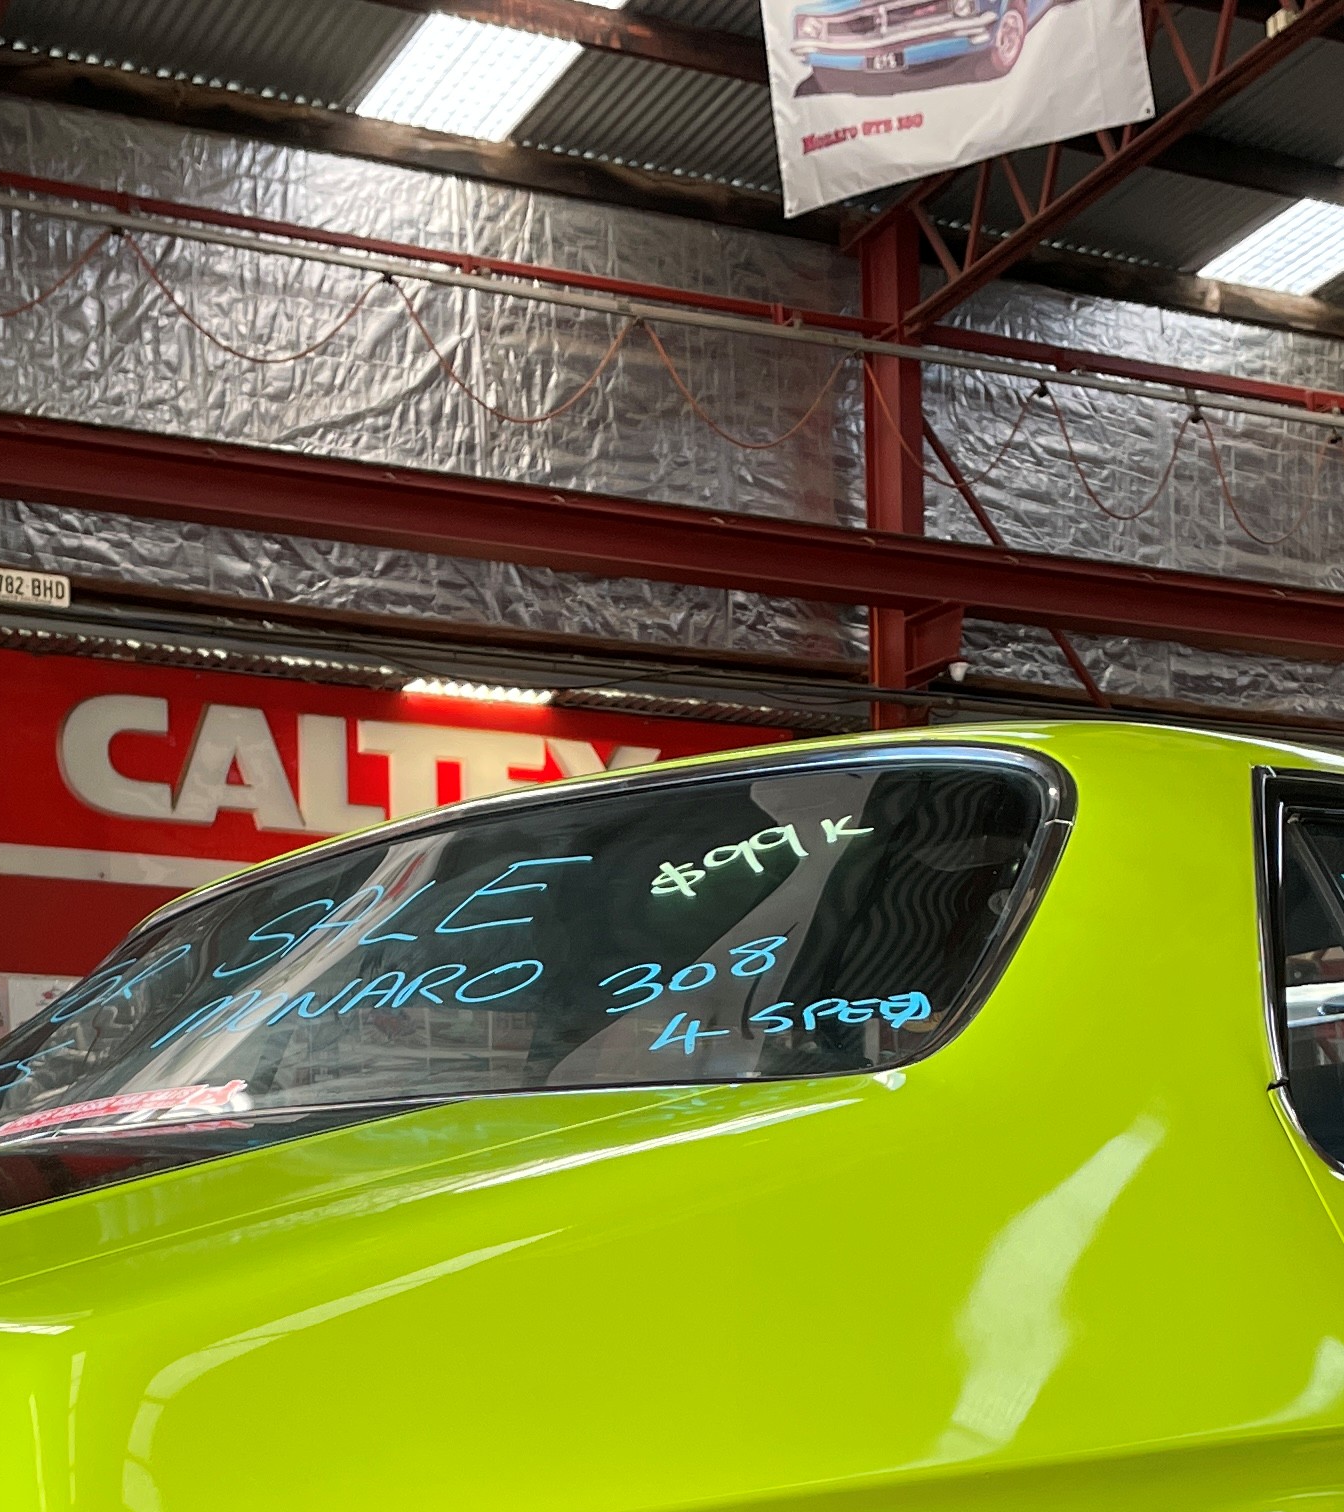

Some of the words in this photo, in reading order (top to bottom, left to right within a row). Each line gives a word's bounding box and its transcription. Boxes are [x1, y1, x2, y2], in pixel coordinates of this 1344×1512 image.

[32, 579, 67, 600] BHD
[57, 694, 660, 832] CALTE
[213, 855, 593, 979] SALE
[650, 824, 809, 897] $99
[151, 960, 545, 1049] MONARO
[598, 935, 788, 1014] 308
